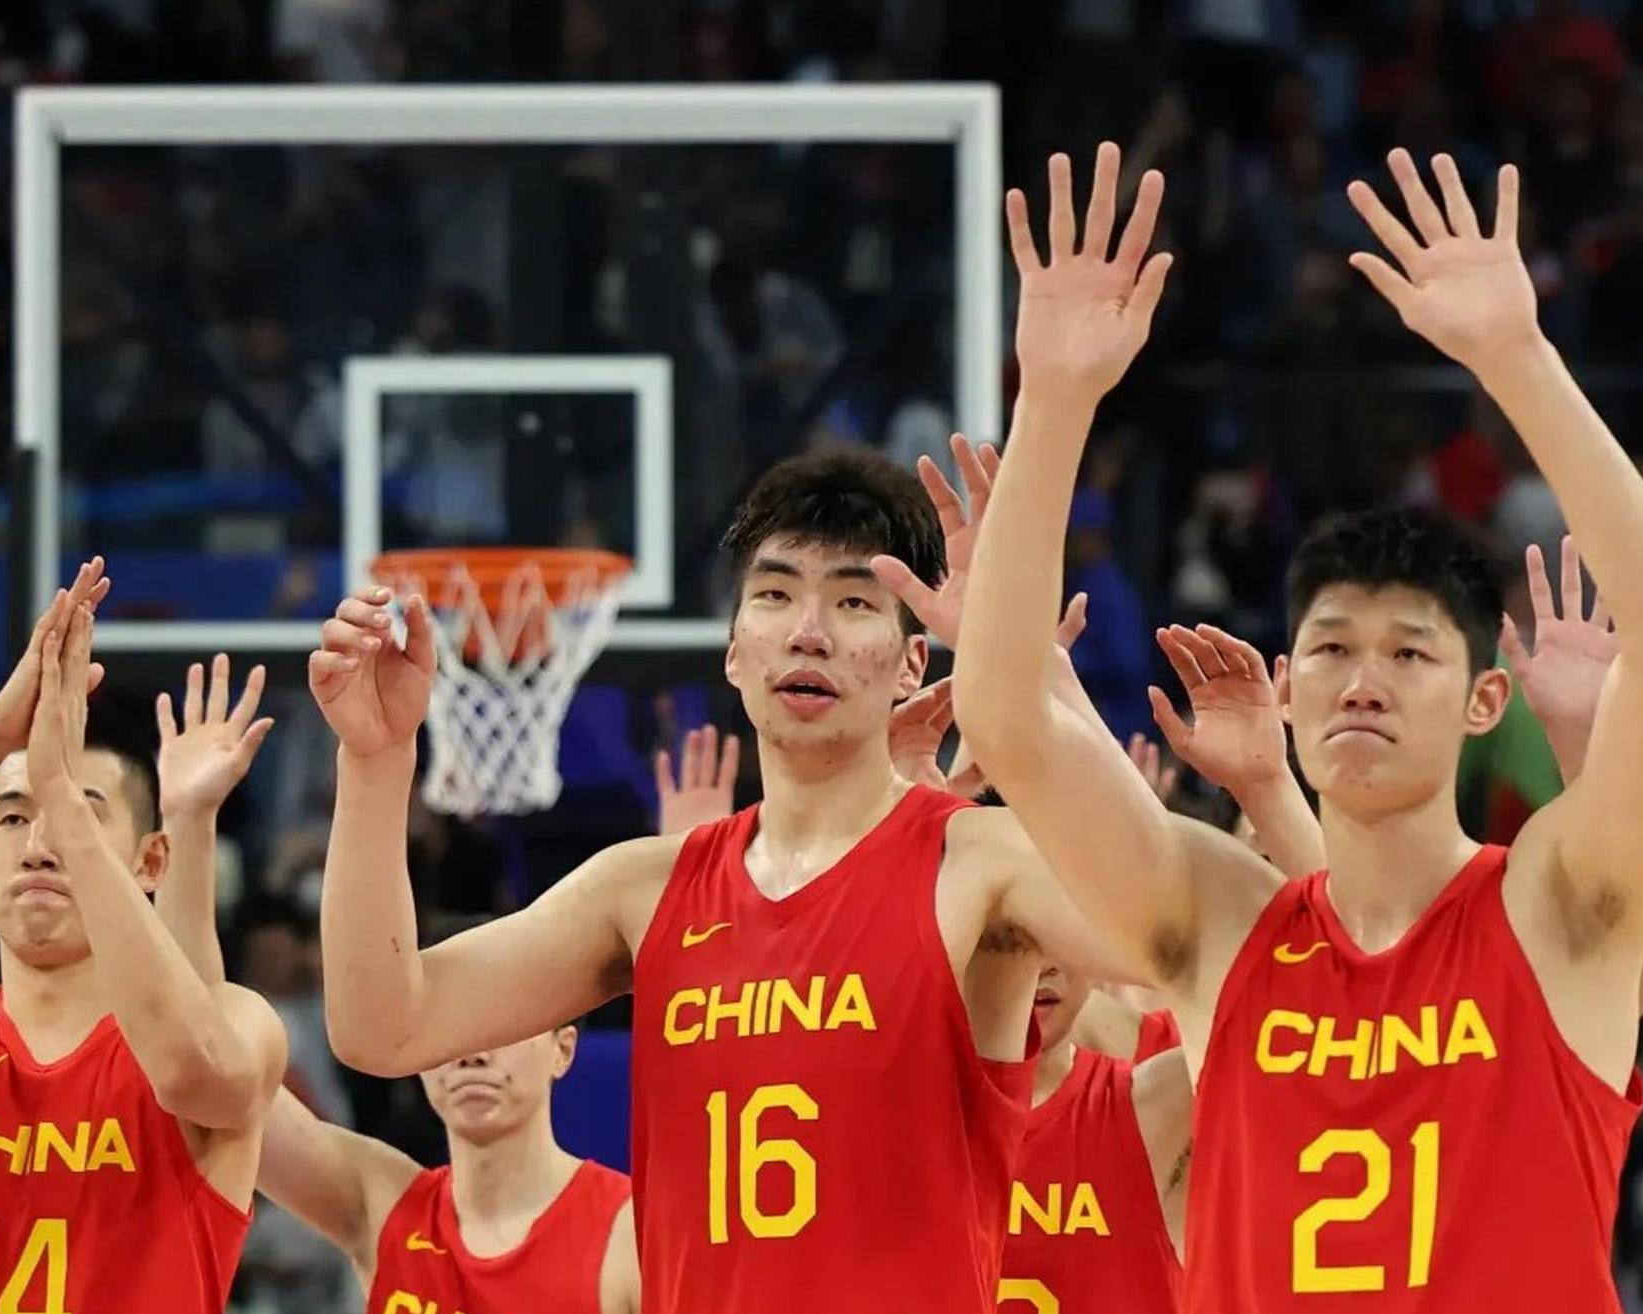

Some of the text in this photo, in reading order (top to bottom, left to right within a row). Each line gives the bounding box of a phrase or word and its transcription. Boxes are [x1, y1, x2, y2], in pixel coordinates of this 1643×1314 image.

[663, 973, 877, 1046] CHINA
[1256, 998, 1498, 1080] CHINA
[706, 1083, 818, 1244] 16
[1292, 1121, 1440, 1293] 21
